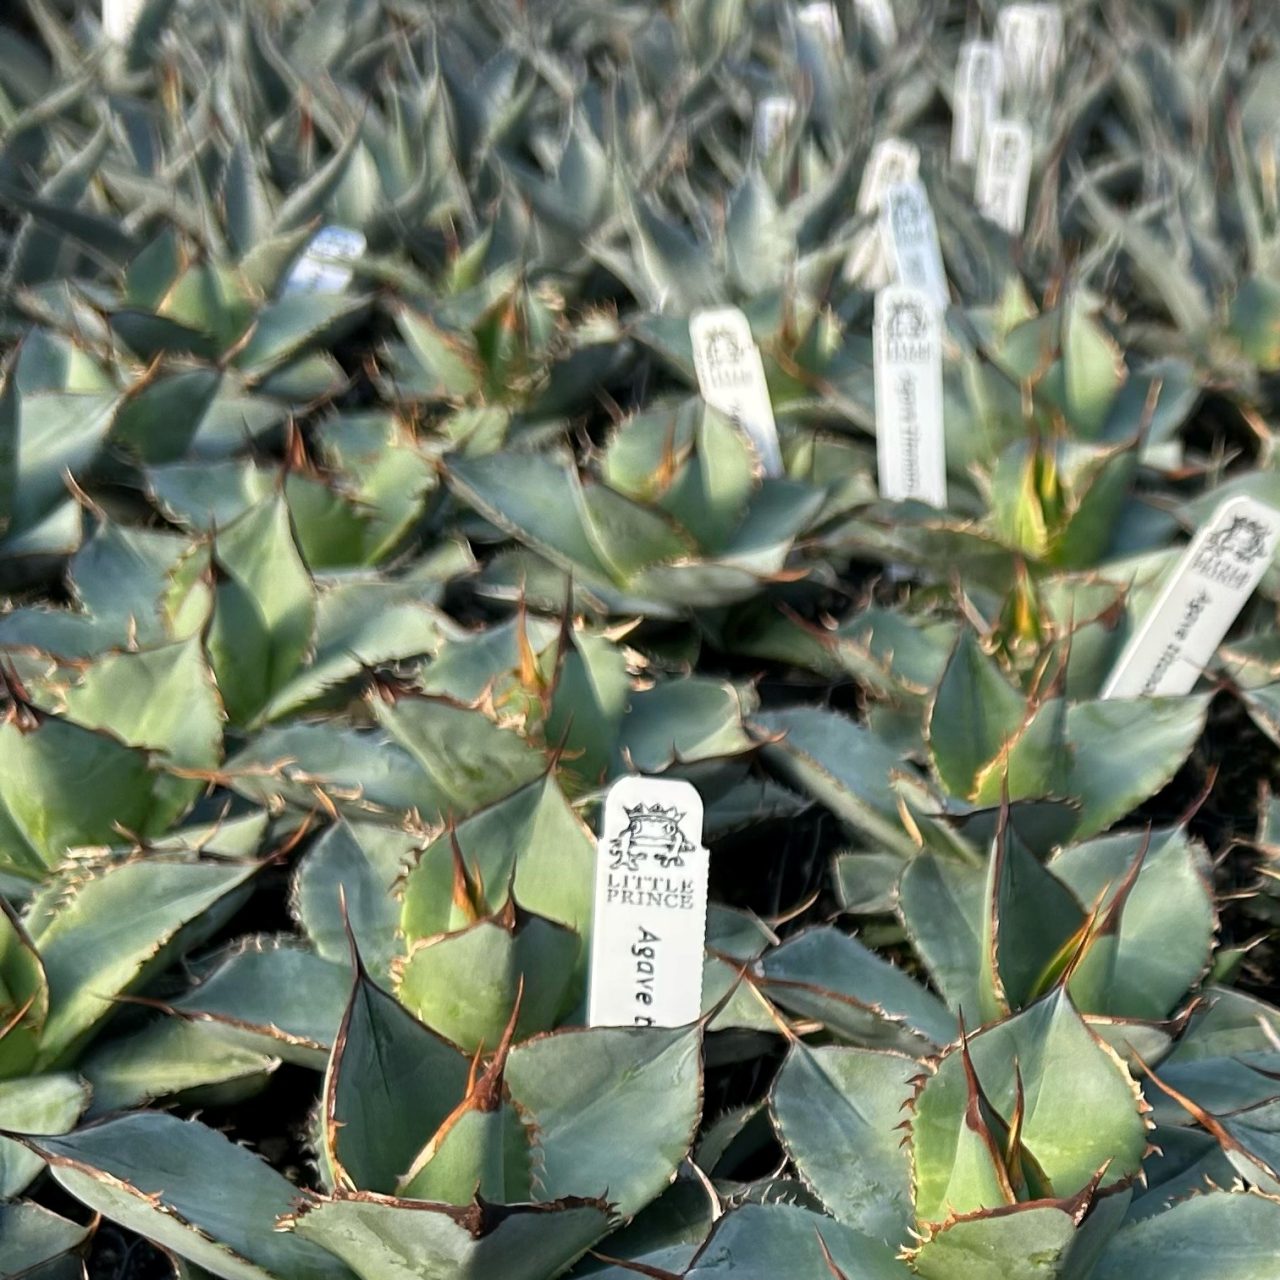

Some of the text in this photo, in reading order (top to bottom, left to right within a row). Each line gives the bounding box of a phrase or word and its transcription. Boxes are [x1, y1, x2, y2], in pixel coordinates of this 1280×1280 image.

[607, 873, 694, 894] LITTLE
[607, 888, 694, 910] PRINCE
[631, 925, 662, 1005] Agave
